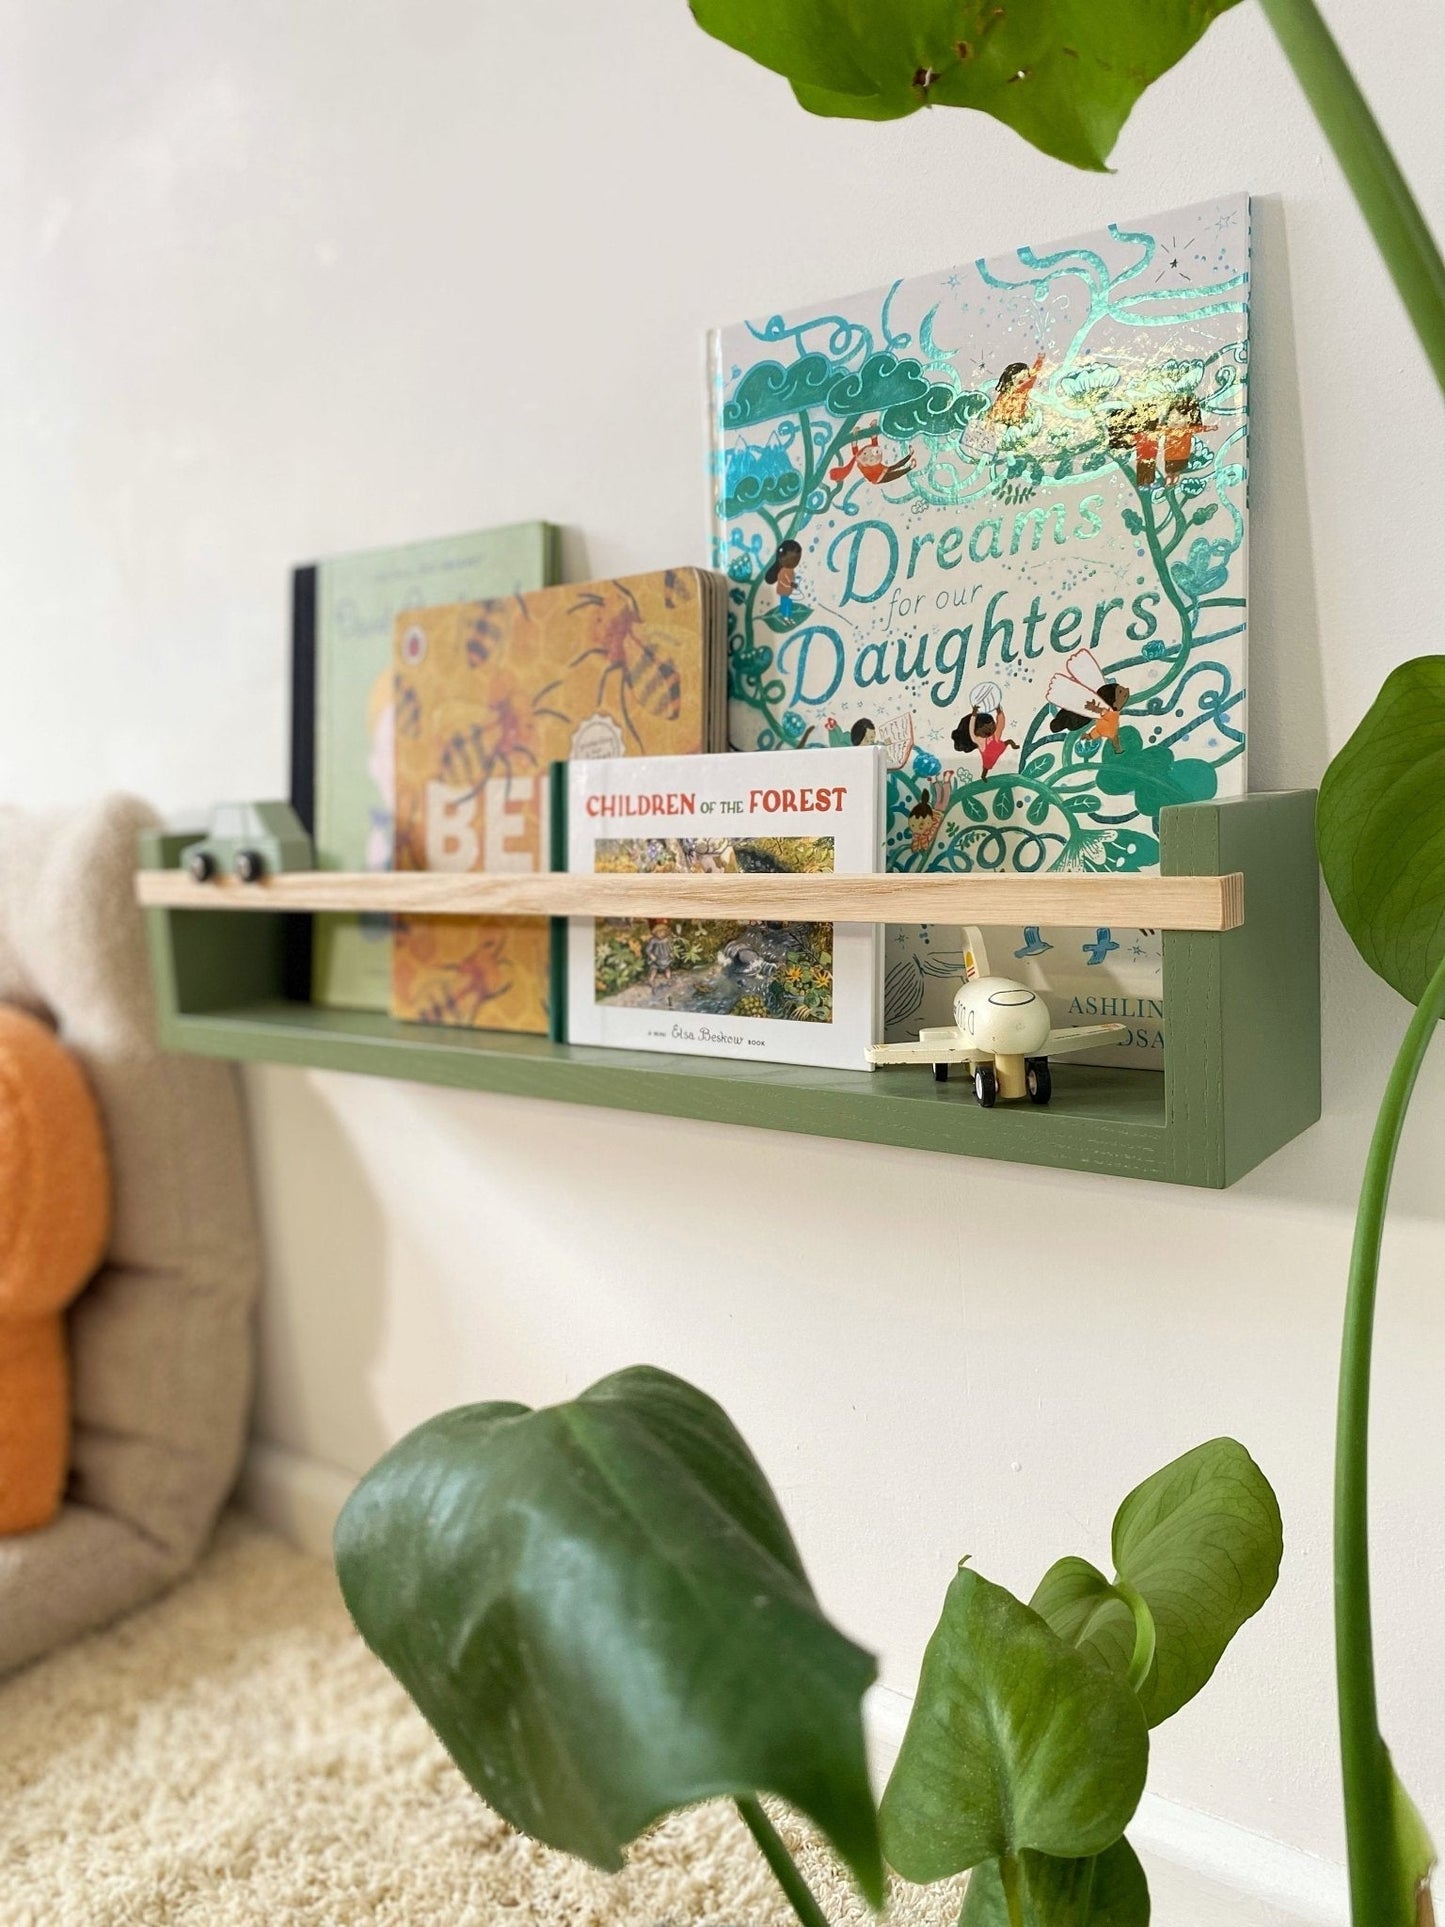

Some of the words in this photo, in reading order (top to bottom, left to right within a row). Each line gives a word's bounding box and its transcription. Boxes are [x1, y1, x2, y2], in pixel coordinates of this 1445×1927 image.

[827, 495, 1104, 607] Dreams
[885, 587, 927, 631] for
[936, 584, 983, 609] our
[778, 590, 1160, 708] Daughters
[427, 777, 550, 873] BE
[587, 794, 696, 818] CHILDREN
[700, 801, 715, 814] OF
[720, 800, 744, 814] THE
[749, 787, 848, 814] FOREST
[671, 1024, 696, 1041] Elsa
[698, 1027, 744, 1045] Beskow
